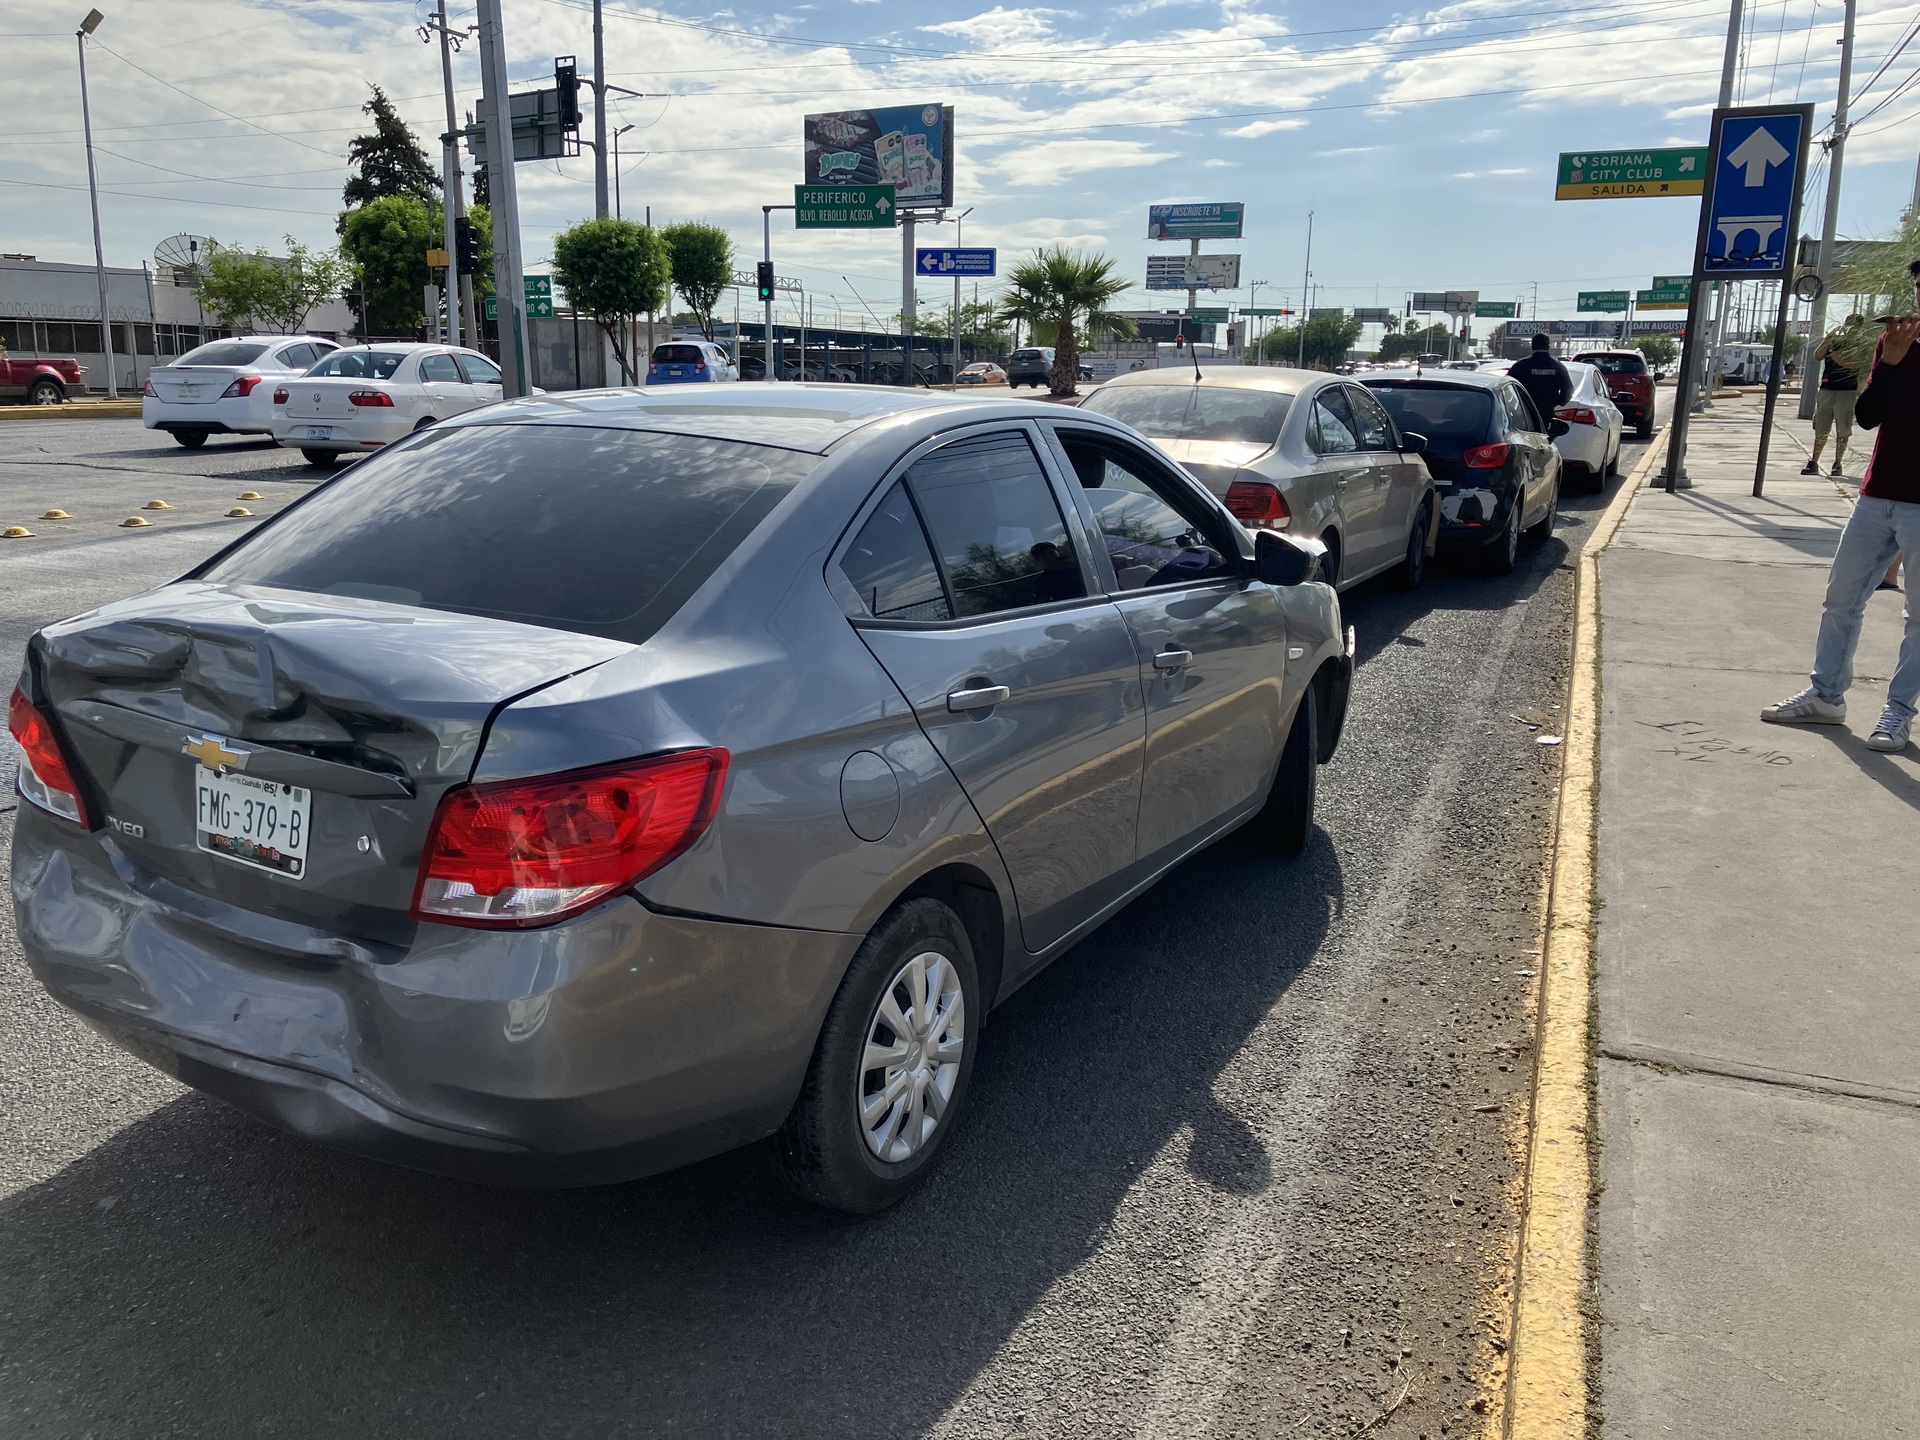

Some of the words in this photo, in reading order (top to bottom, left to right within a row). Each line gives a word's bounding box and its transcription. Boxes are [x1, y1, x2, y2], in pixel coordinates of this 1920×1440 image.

[818, 151, 862, 178] BOING!
[1591, 154, 1653, 167] SORIANA
[1590, 169, 1621, 181] CITY
[1627, 167, 1663, 180] CLUB
[1591, 184, 1646, 196] SALIDA
[803, 191, 866, 204] PERIFERICO
[800, 209, 818, 222] BLVD.
[819, 209, 847, 222] REBOLLO
[849, 208, 874, 221] ACOSTA
[1211, 205, 1221, 216] YA
[241, 778, 262, 790] Coahuila
[263, 782, 279, 797] es!
[198, 786, 302, 850] FMG-379-B
